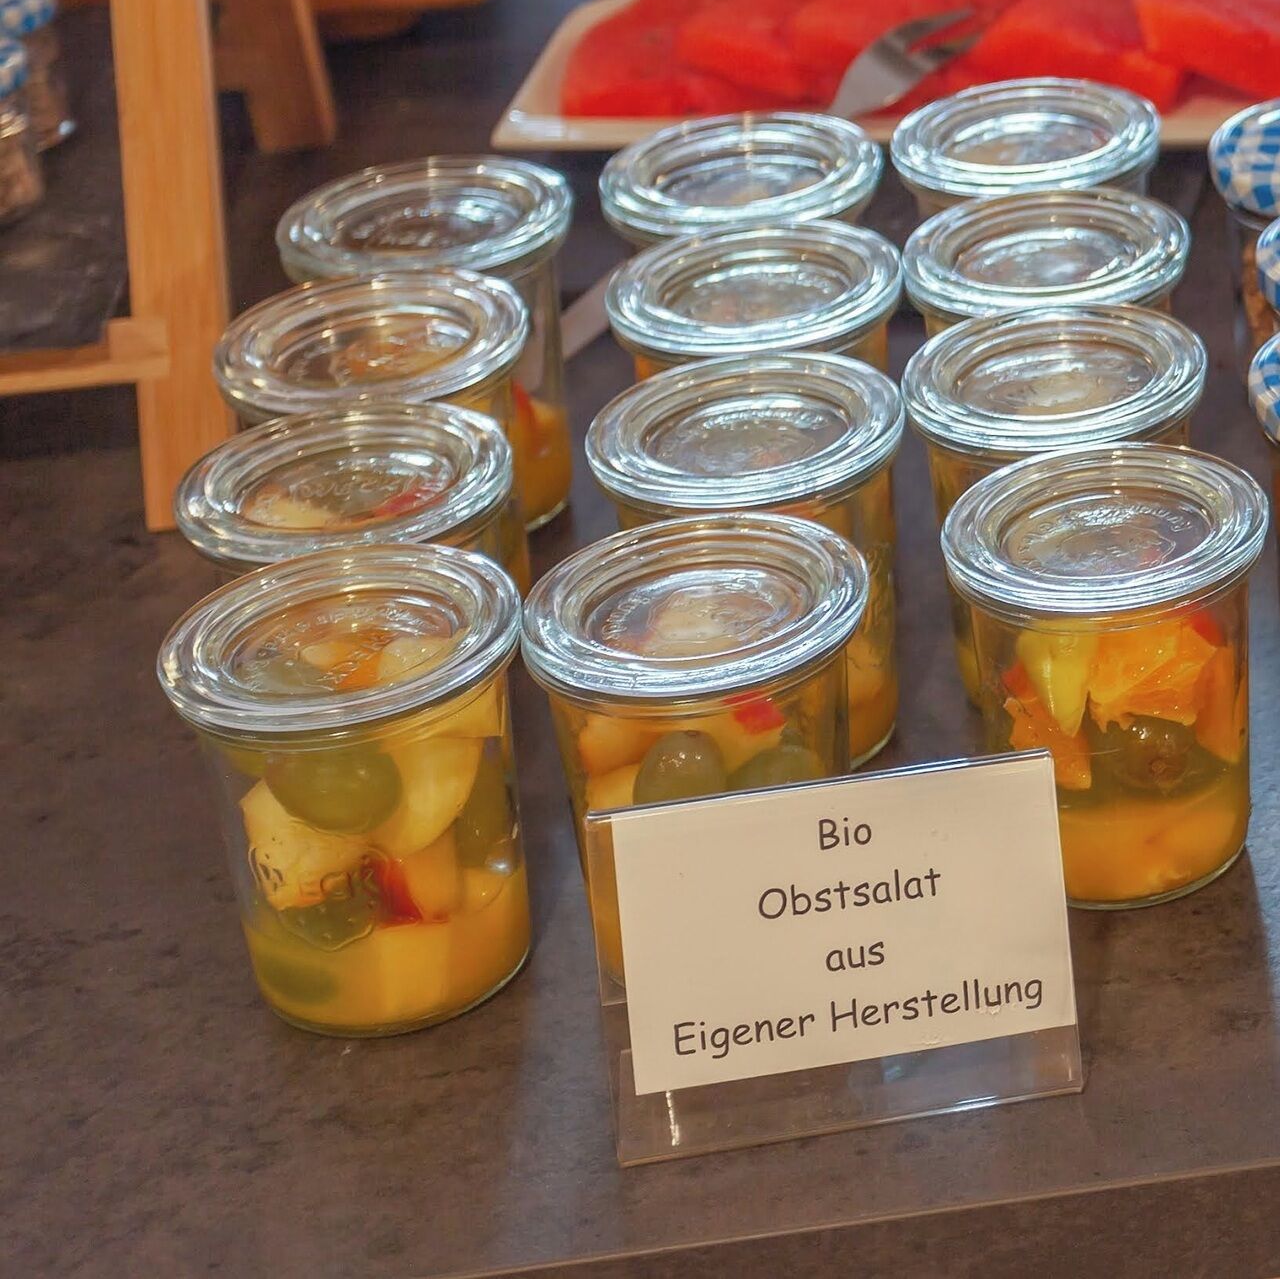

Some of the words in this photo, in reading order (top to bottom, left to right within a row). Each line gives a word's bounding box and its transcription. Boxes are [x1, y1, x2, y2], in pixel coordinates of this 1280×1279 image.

[818, 816, 873, 851] Bio
[757, 867, 942, 920] Obstsalat
[825, 939, 886, 972] aus
[672, 1013, 816, 1060] Eigener
[829, 977, 1045, 1033] Herstellung
